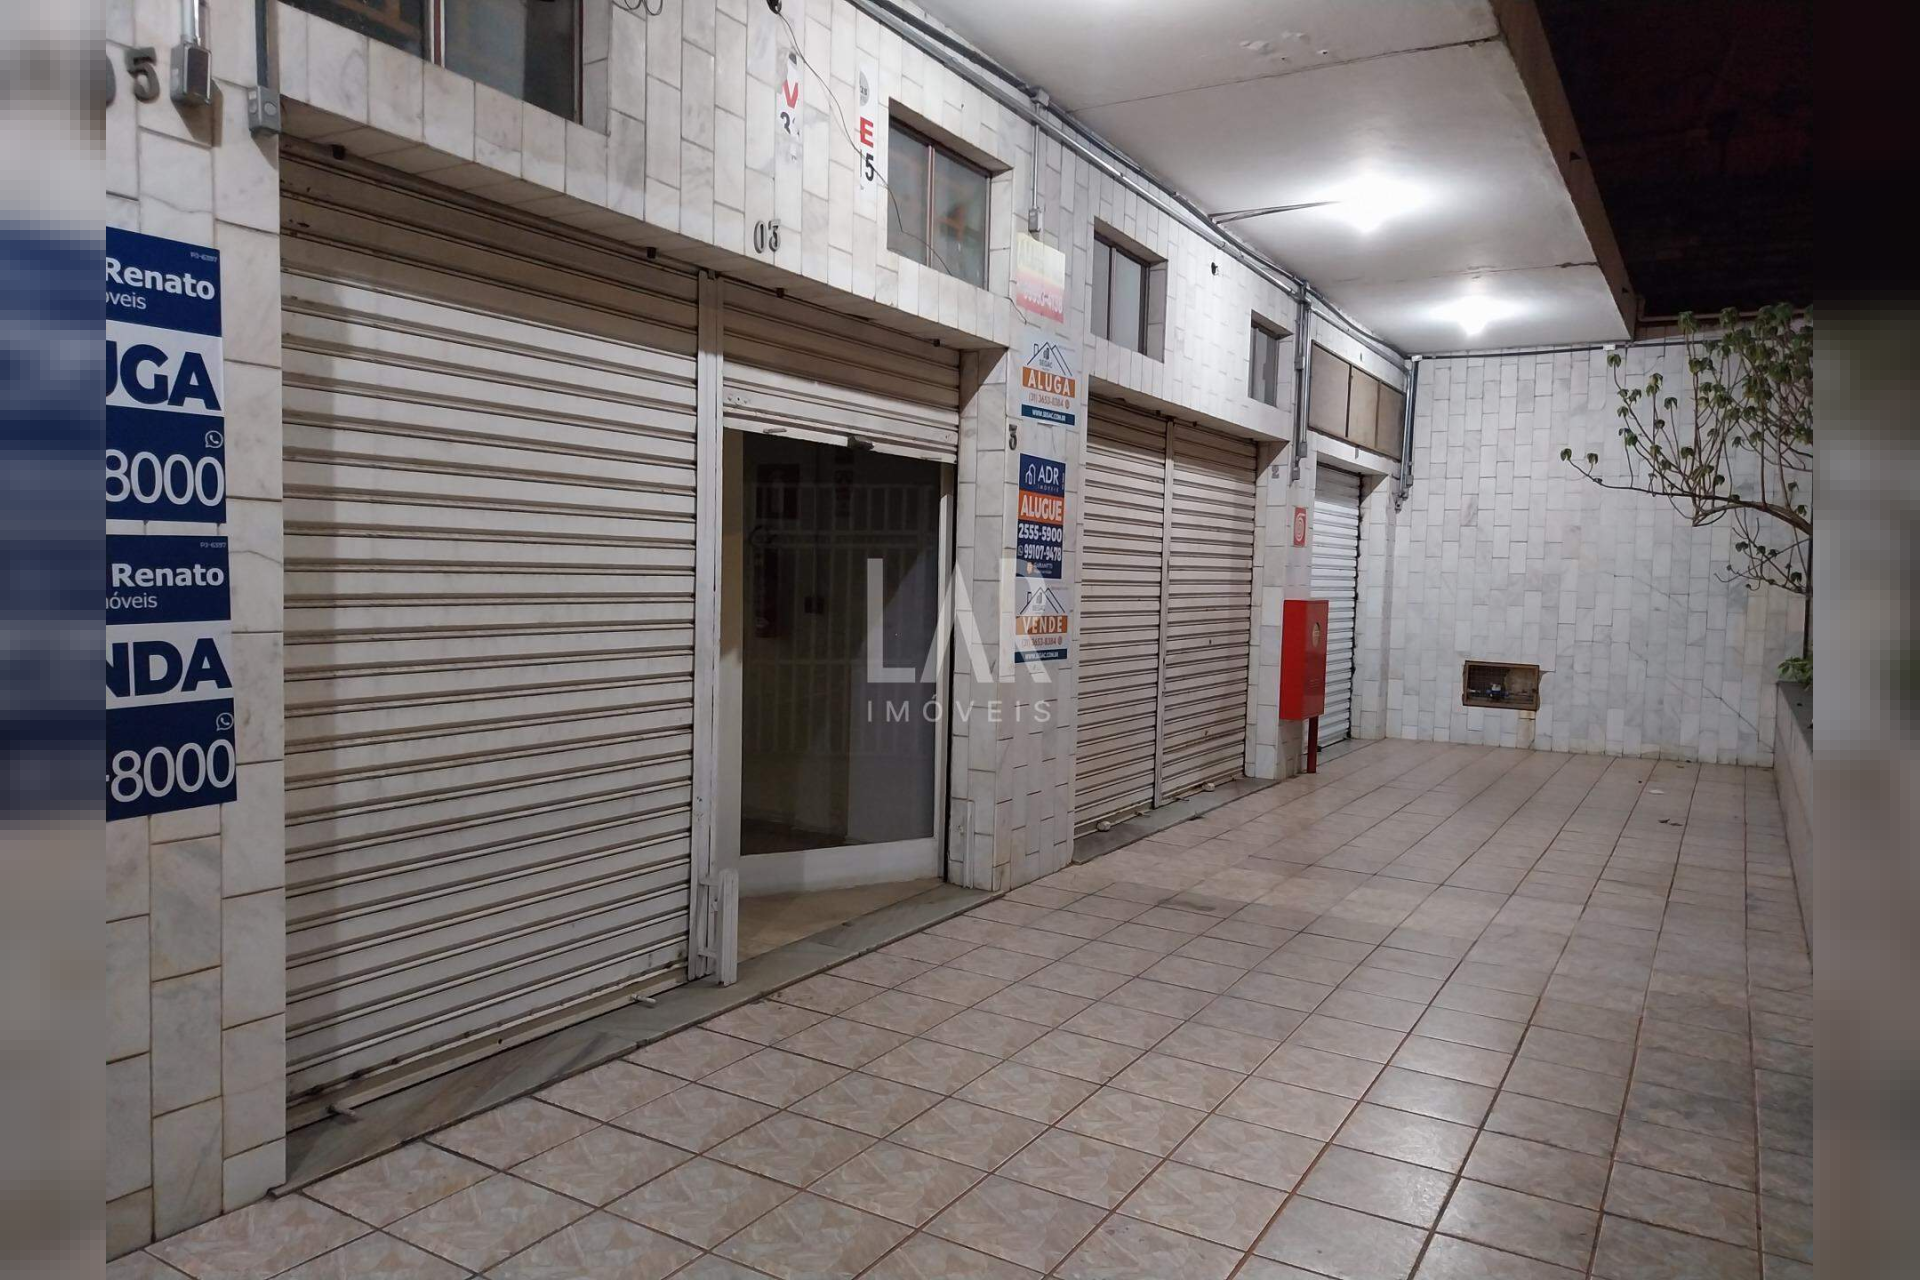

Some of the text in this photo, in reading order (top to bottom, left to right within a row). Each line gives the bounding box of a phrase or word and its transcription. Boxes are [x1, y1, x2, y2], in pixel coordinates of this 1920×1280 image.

[860, 117, 874, 148] E
[754, 219, 782, 254] 03
[106, 256, 216, 300] Renato
[106, 292, 147, 311] veis
[1027, 369, 1071, 396] ALUGA
[106, 448, 225, 507] 8000
[1037, 464, 1060, 486] ADR
[1020, 494, 1063, 522] ALUGUE
[1018, 522, 1063, 543] 2555-5900
[1023, 543, 1062, 562] 99107-9478
[112, 563, 225, 588] Renato
[106, 592, 158, 610] óveis
[1022, 616, 1063, 634] VENDE
[106, 738, 236, 803] 8000
